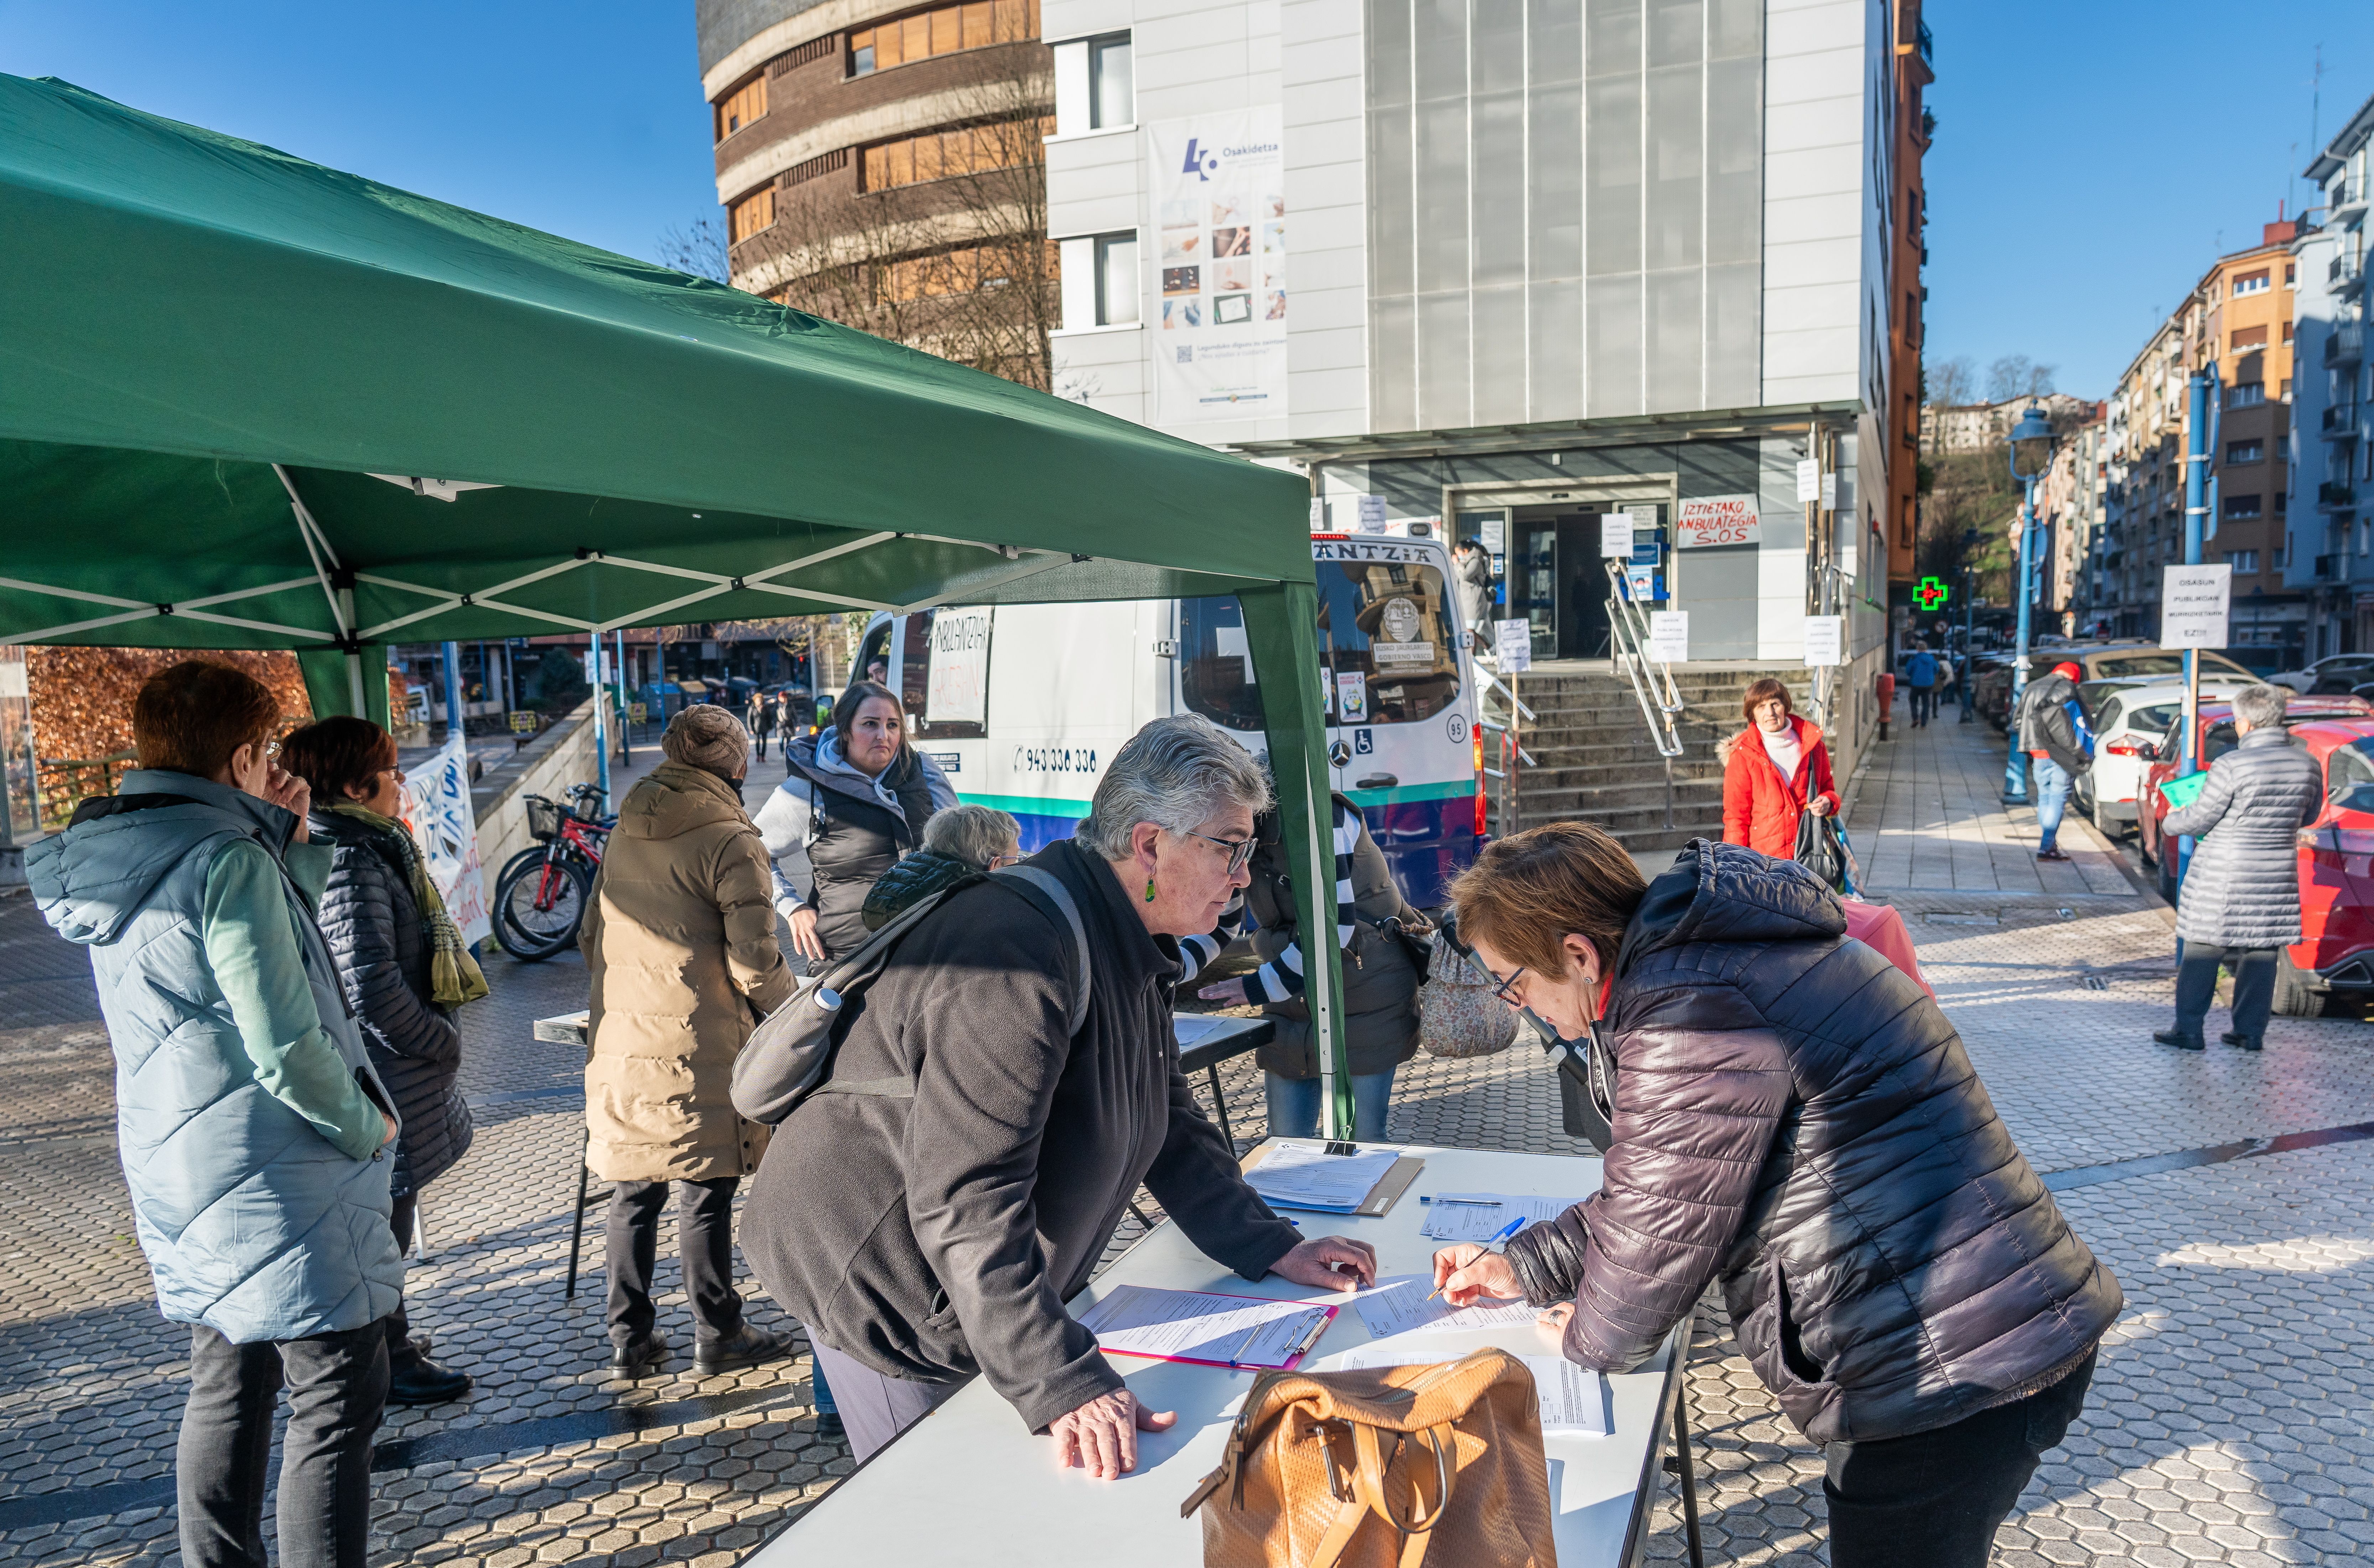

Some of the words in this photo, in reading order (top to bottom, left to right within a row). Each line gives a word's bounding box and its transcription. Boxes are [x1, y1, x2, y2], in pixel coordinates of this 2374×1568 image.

[1223, 143, 1278, 157] Osakidetza
[1451, 722, 1461, 735] 95
[1027, 748, 1046, 772] 943
